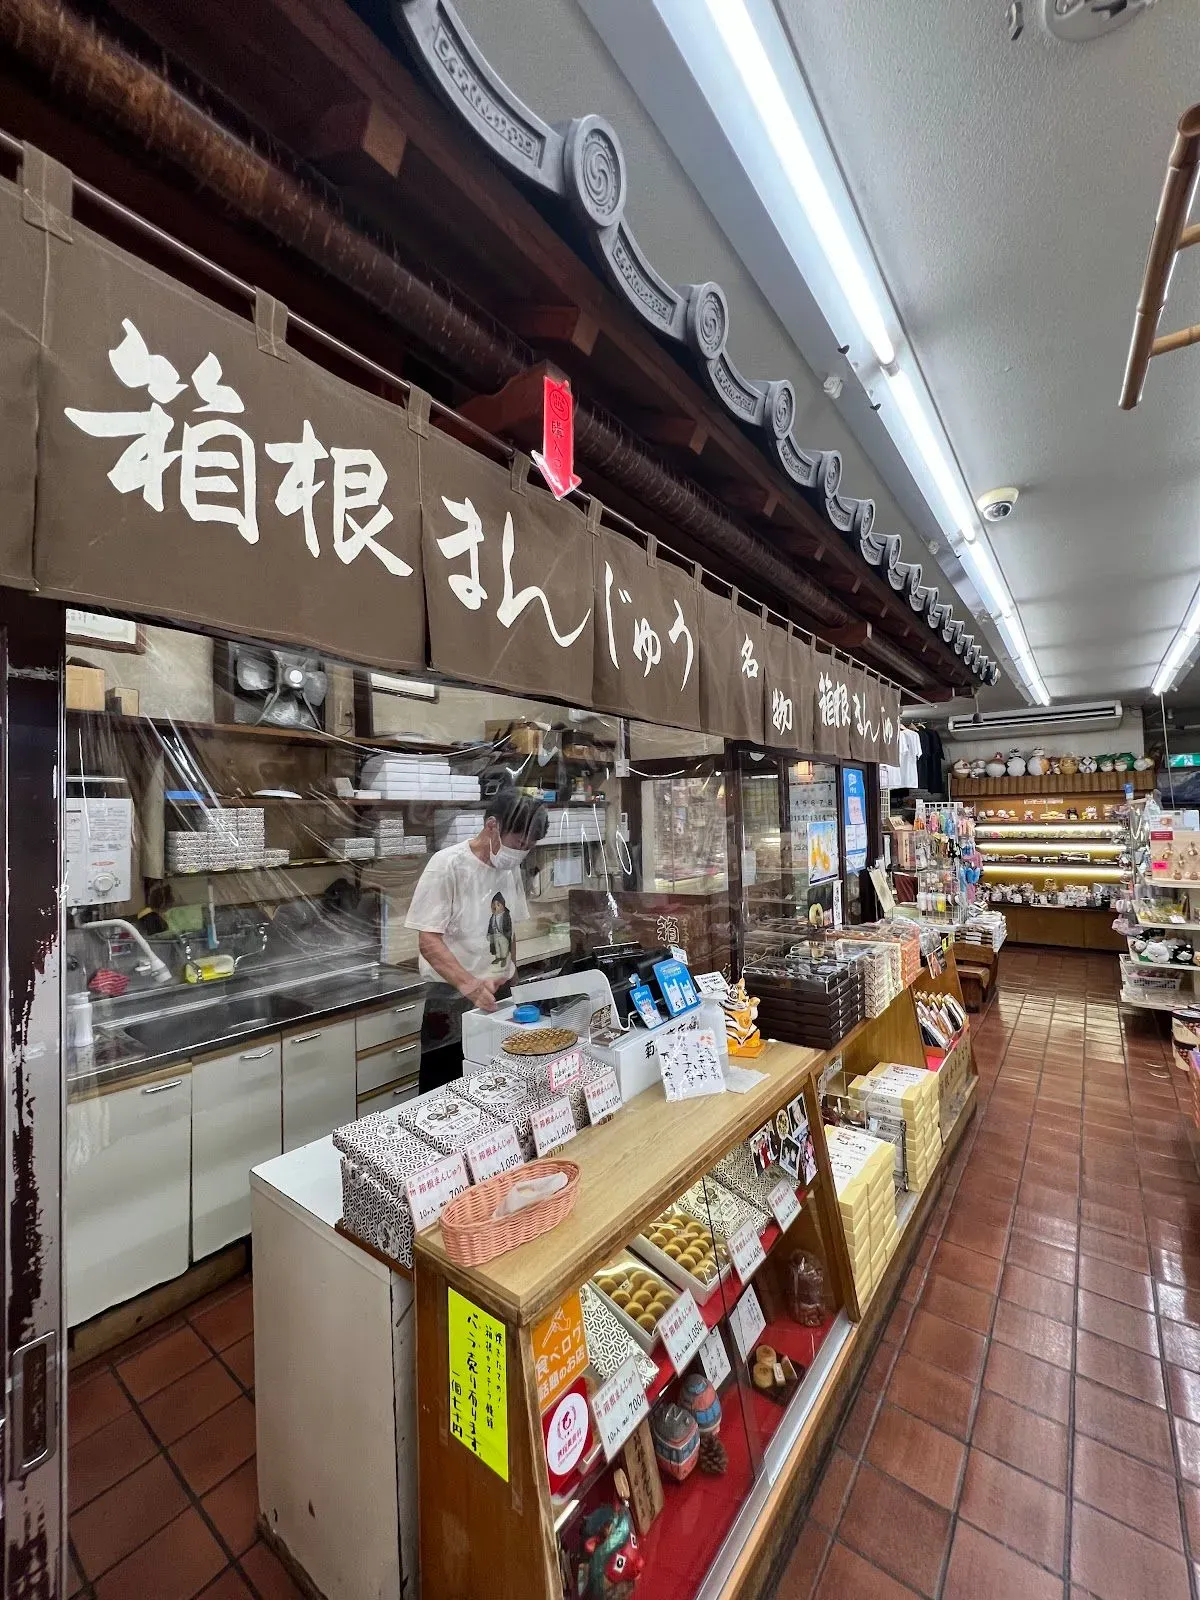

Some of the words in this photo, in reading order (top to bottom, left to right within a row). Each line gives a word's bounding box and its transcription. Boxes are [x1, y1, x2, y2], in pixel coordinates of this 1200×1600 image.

[64, 318, 694, 692] 箱根まんじゅう
[535, 1322, 582, 1382] 食べログ
[538, 1343, 586, 1403] 話題のお店
